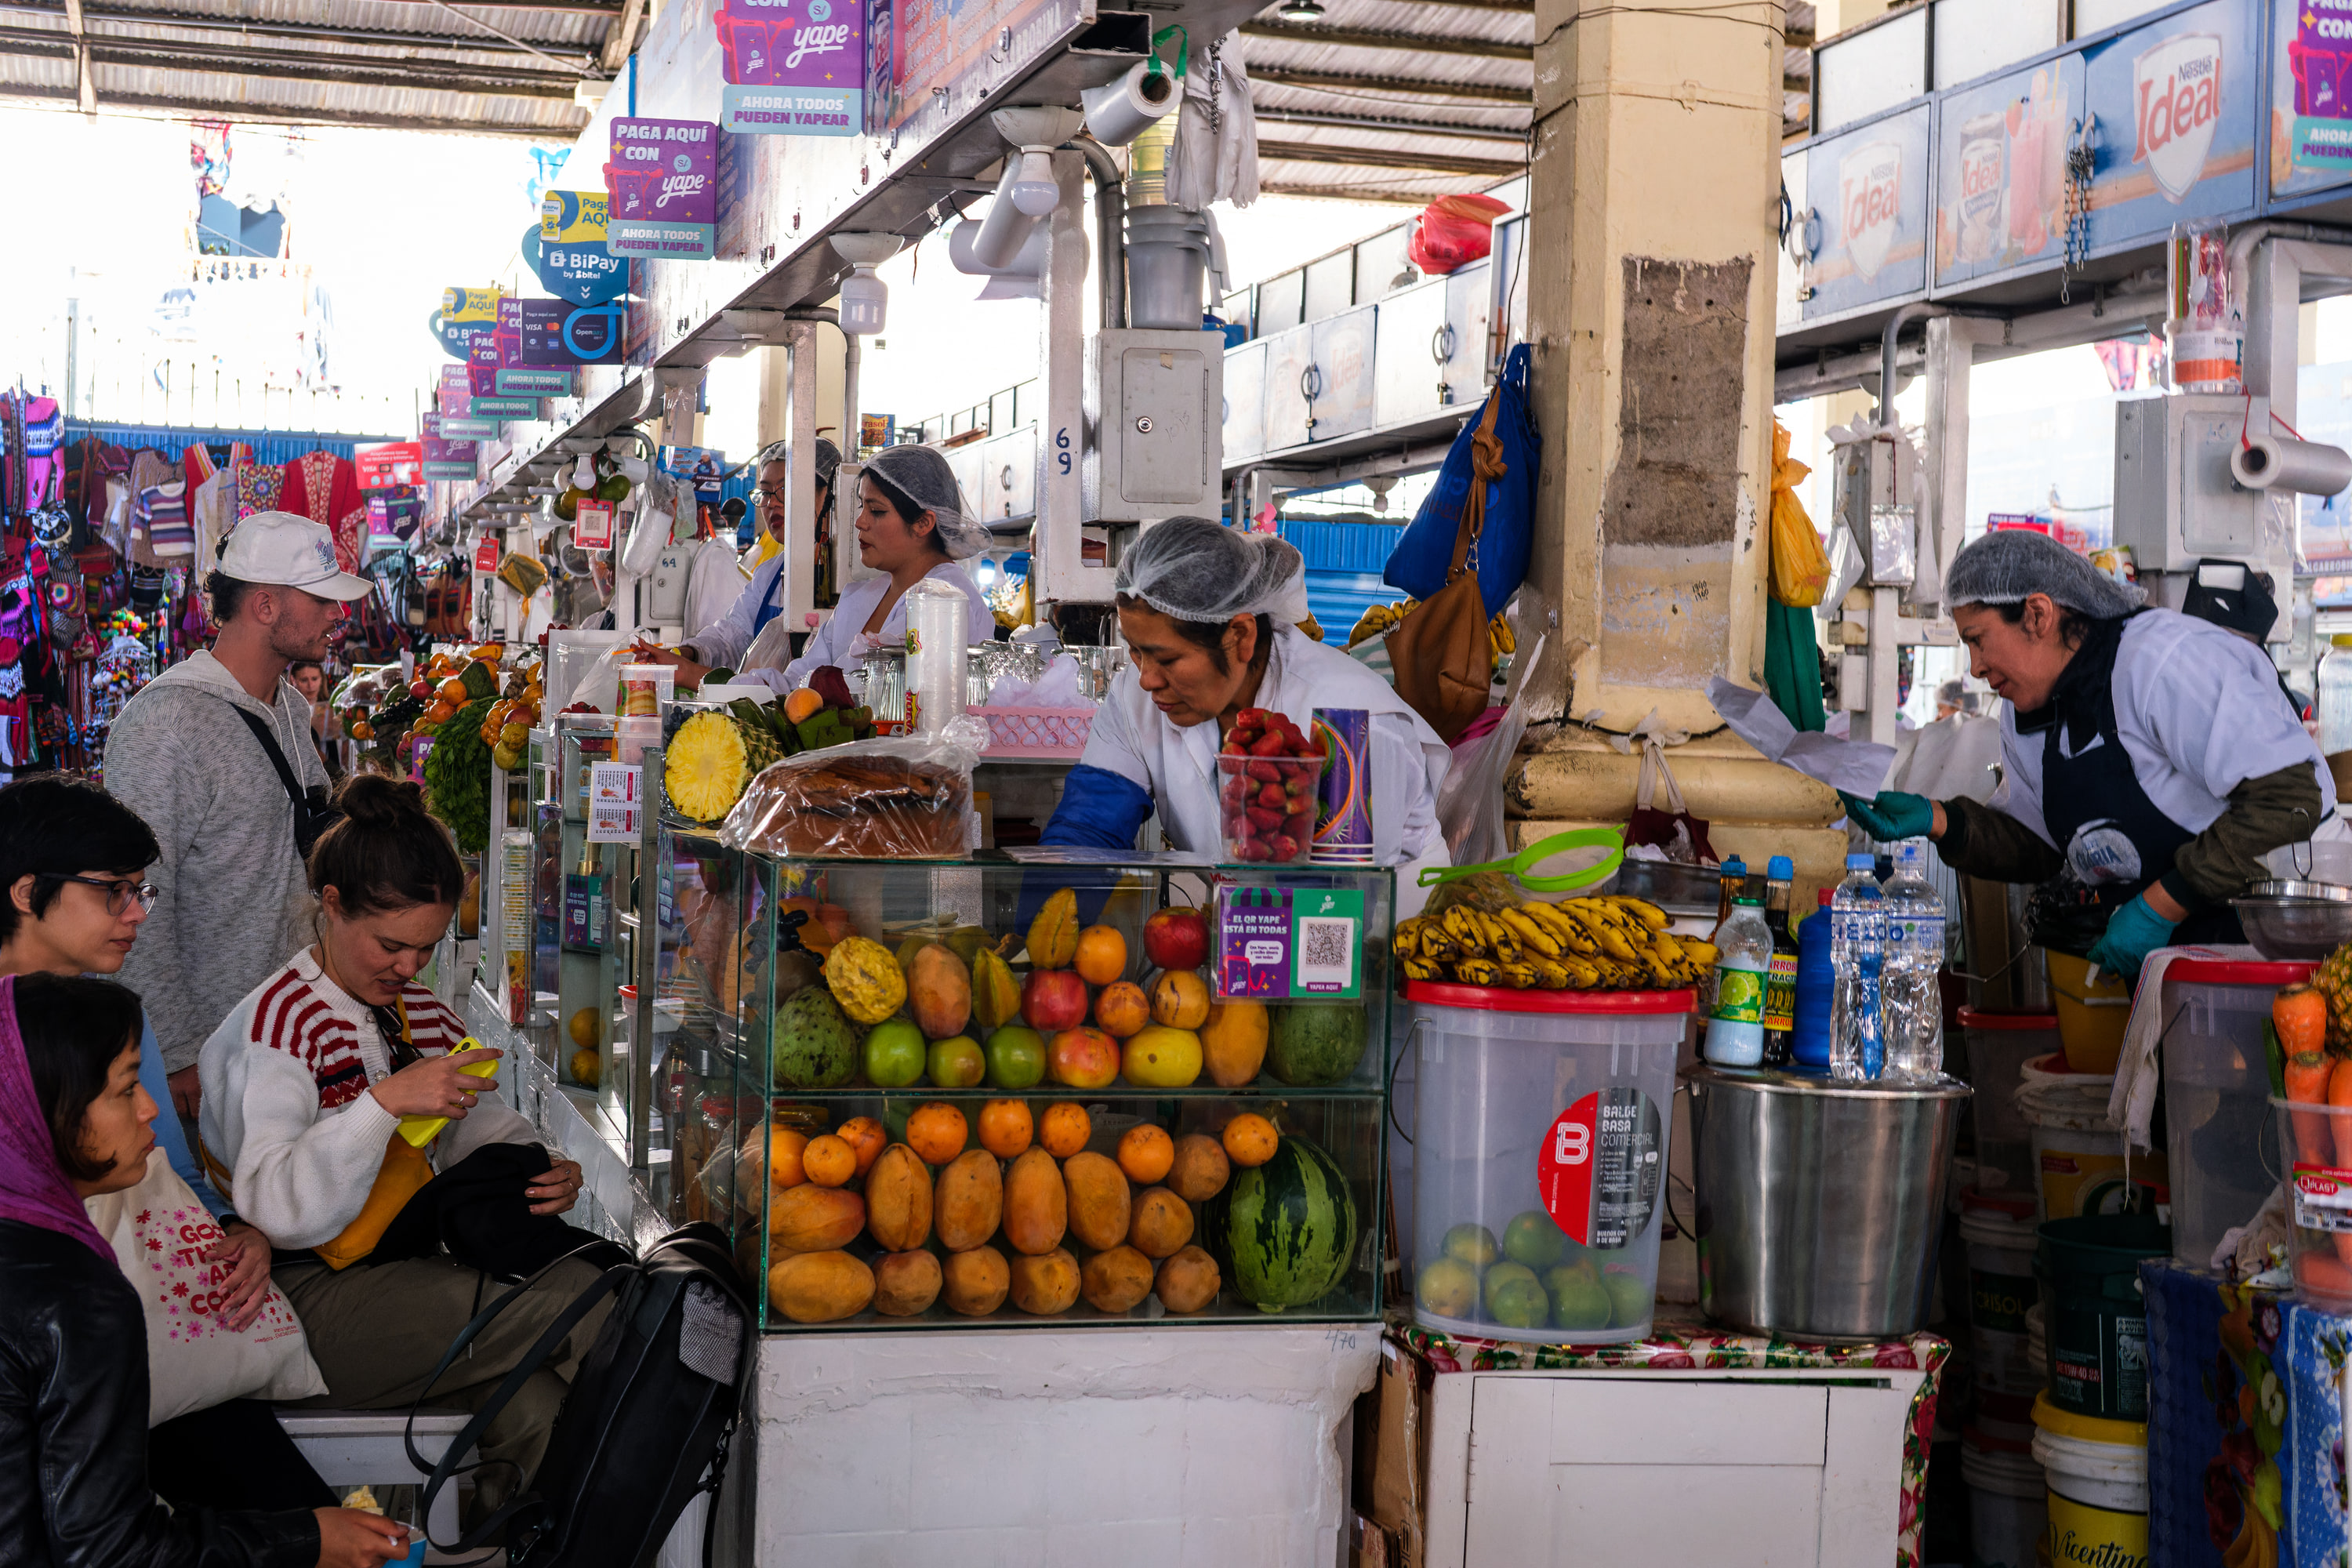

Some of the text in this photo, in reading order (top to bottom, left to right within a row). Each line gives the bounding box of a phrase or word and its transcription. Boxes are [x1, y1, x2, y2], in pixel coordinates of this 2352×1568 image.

[786, 24, 848, 68] yape
[742, 96, 844, 111] AHORA TODOS
[734, 111, 849, 125] PUEDEN YAPEAR
[2132, 58, 2220, 165] Ideal
[616, 125, 708, 143] PAGA AQUÍ
[626, 147, 659, 161] CON
[1962, 157, 2001, 199] Ideal
[655, 175, 705, 208] yape
[1838, 163, 1900, 249] Ideal
[622, 228, 700, 241] AHORA TODOS
[615, 240, 704, 252] PUEDEN YAPEAR
[571, 254, 619, 273] BiPay
[469, 299, 495, 311] AQUÍ
[509, 318, 521, 328] CO
[662, 557, 677, 568] 64
[1603, 1105, 1637, 1119] BALDE
[1602, 1120, 1632, 1132] BASA
[1555, 1122, 1590, 1164] B
[1601, 1132, 1654, 1148] COMERCIAL
